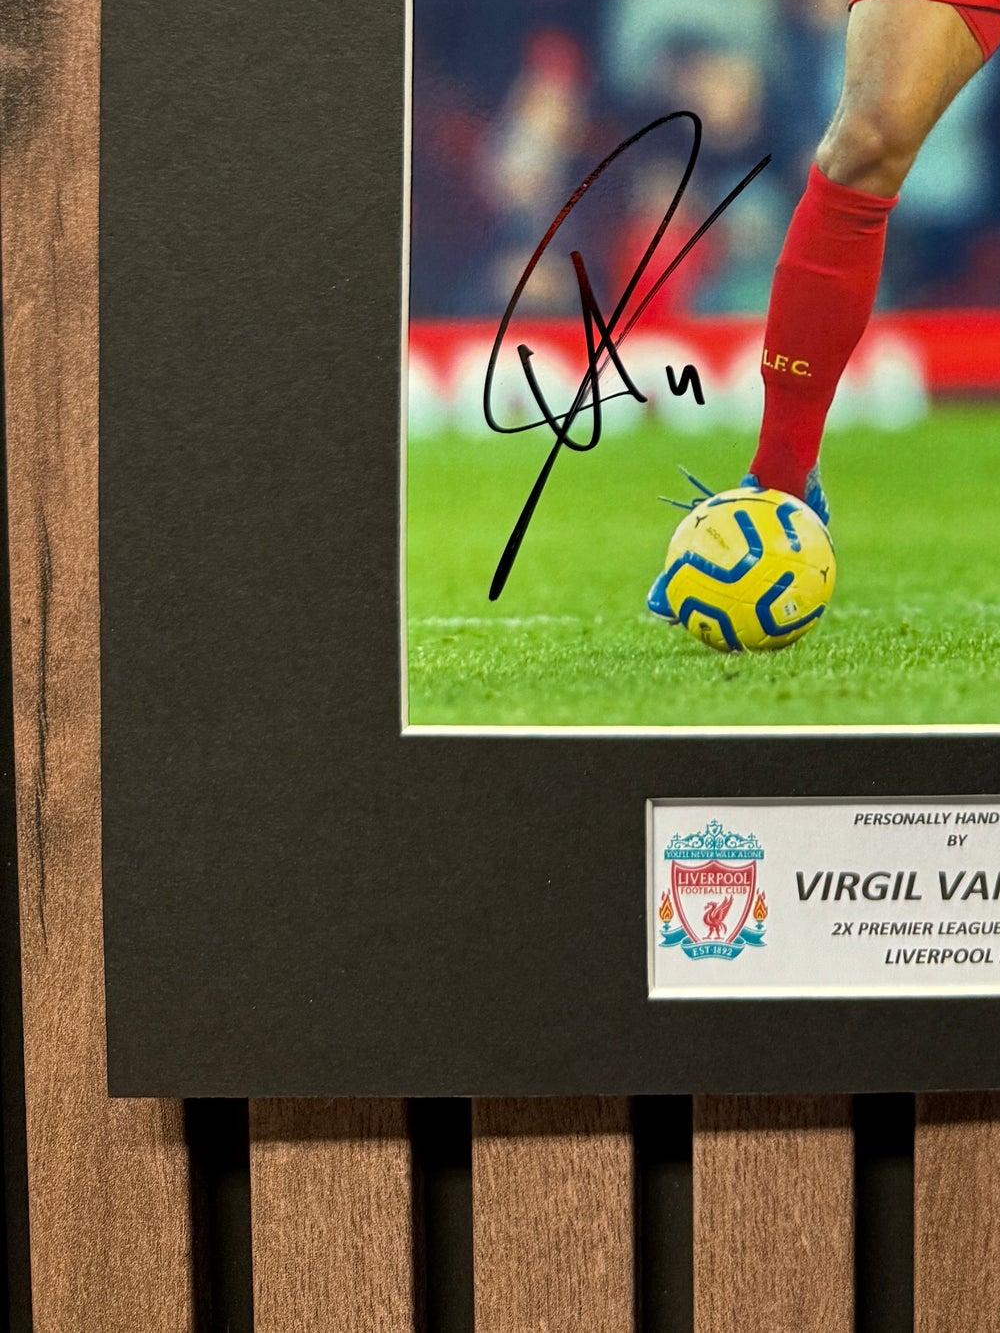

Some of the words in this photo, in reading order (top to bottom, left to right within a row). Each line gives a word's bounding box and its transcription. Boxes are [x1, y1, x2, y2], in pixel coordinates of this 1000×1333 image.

[854, 812, 952, 826] PERSONALLY
[955, 812, 1000, 825] HAND
[947, 834, 968, 847] BY
[678, 872, 750, 885] LIVERPOOL
[681, 886, 722, 895] FOOTBALL
[725, 886, 748, 895] CLUB
[796, 871, 923, 901] VIRGIL
[832, 922, 854, 936] 2X
[858, 922, 934, 936] PREMIER
[884, 948, 994, 964] LIVERPOOL
